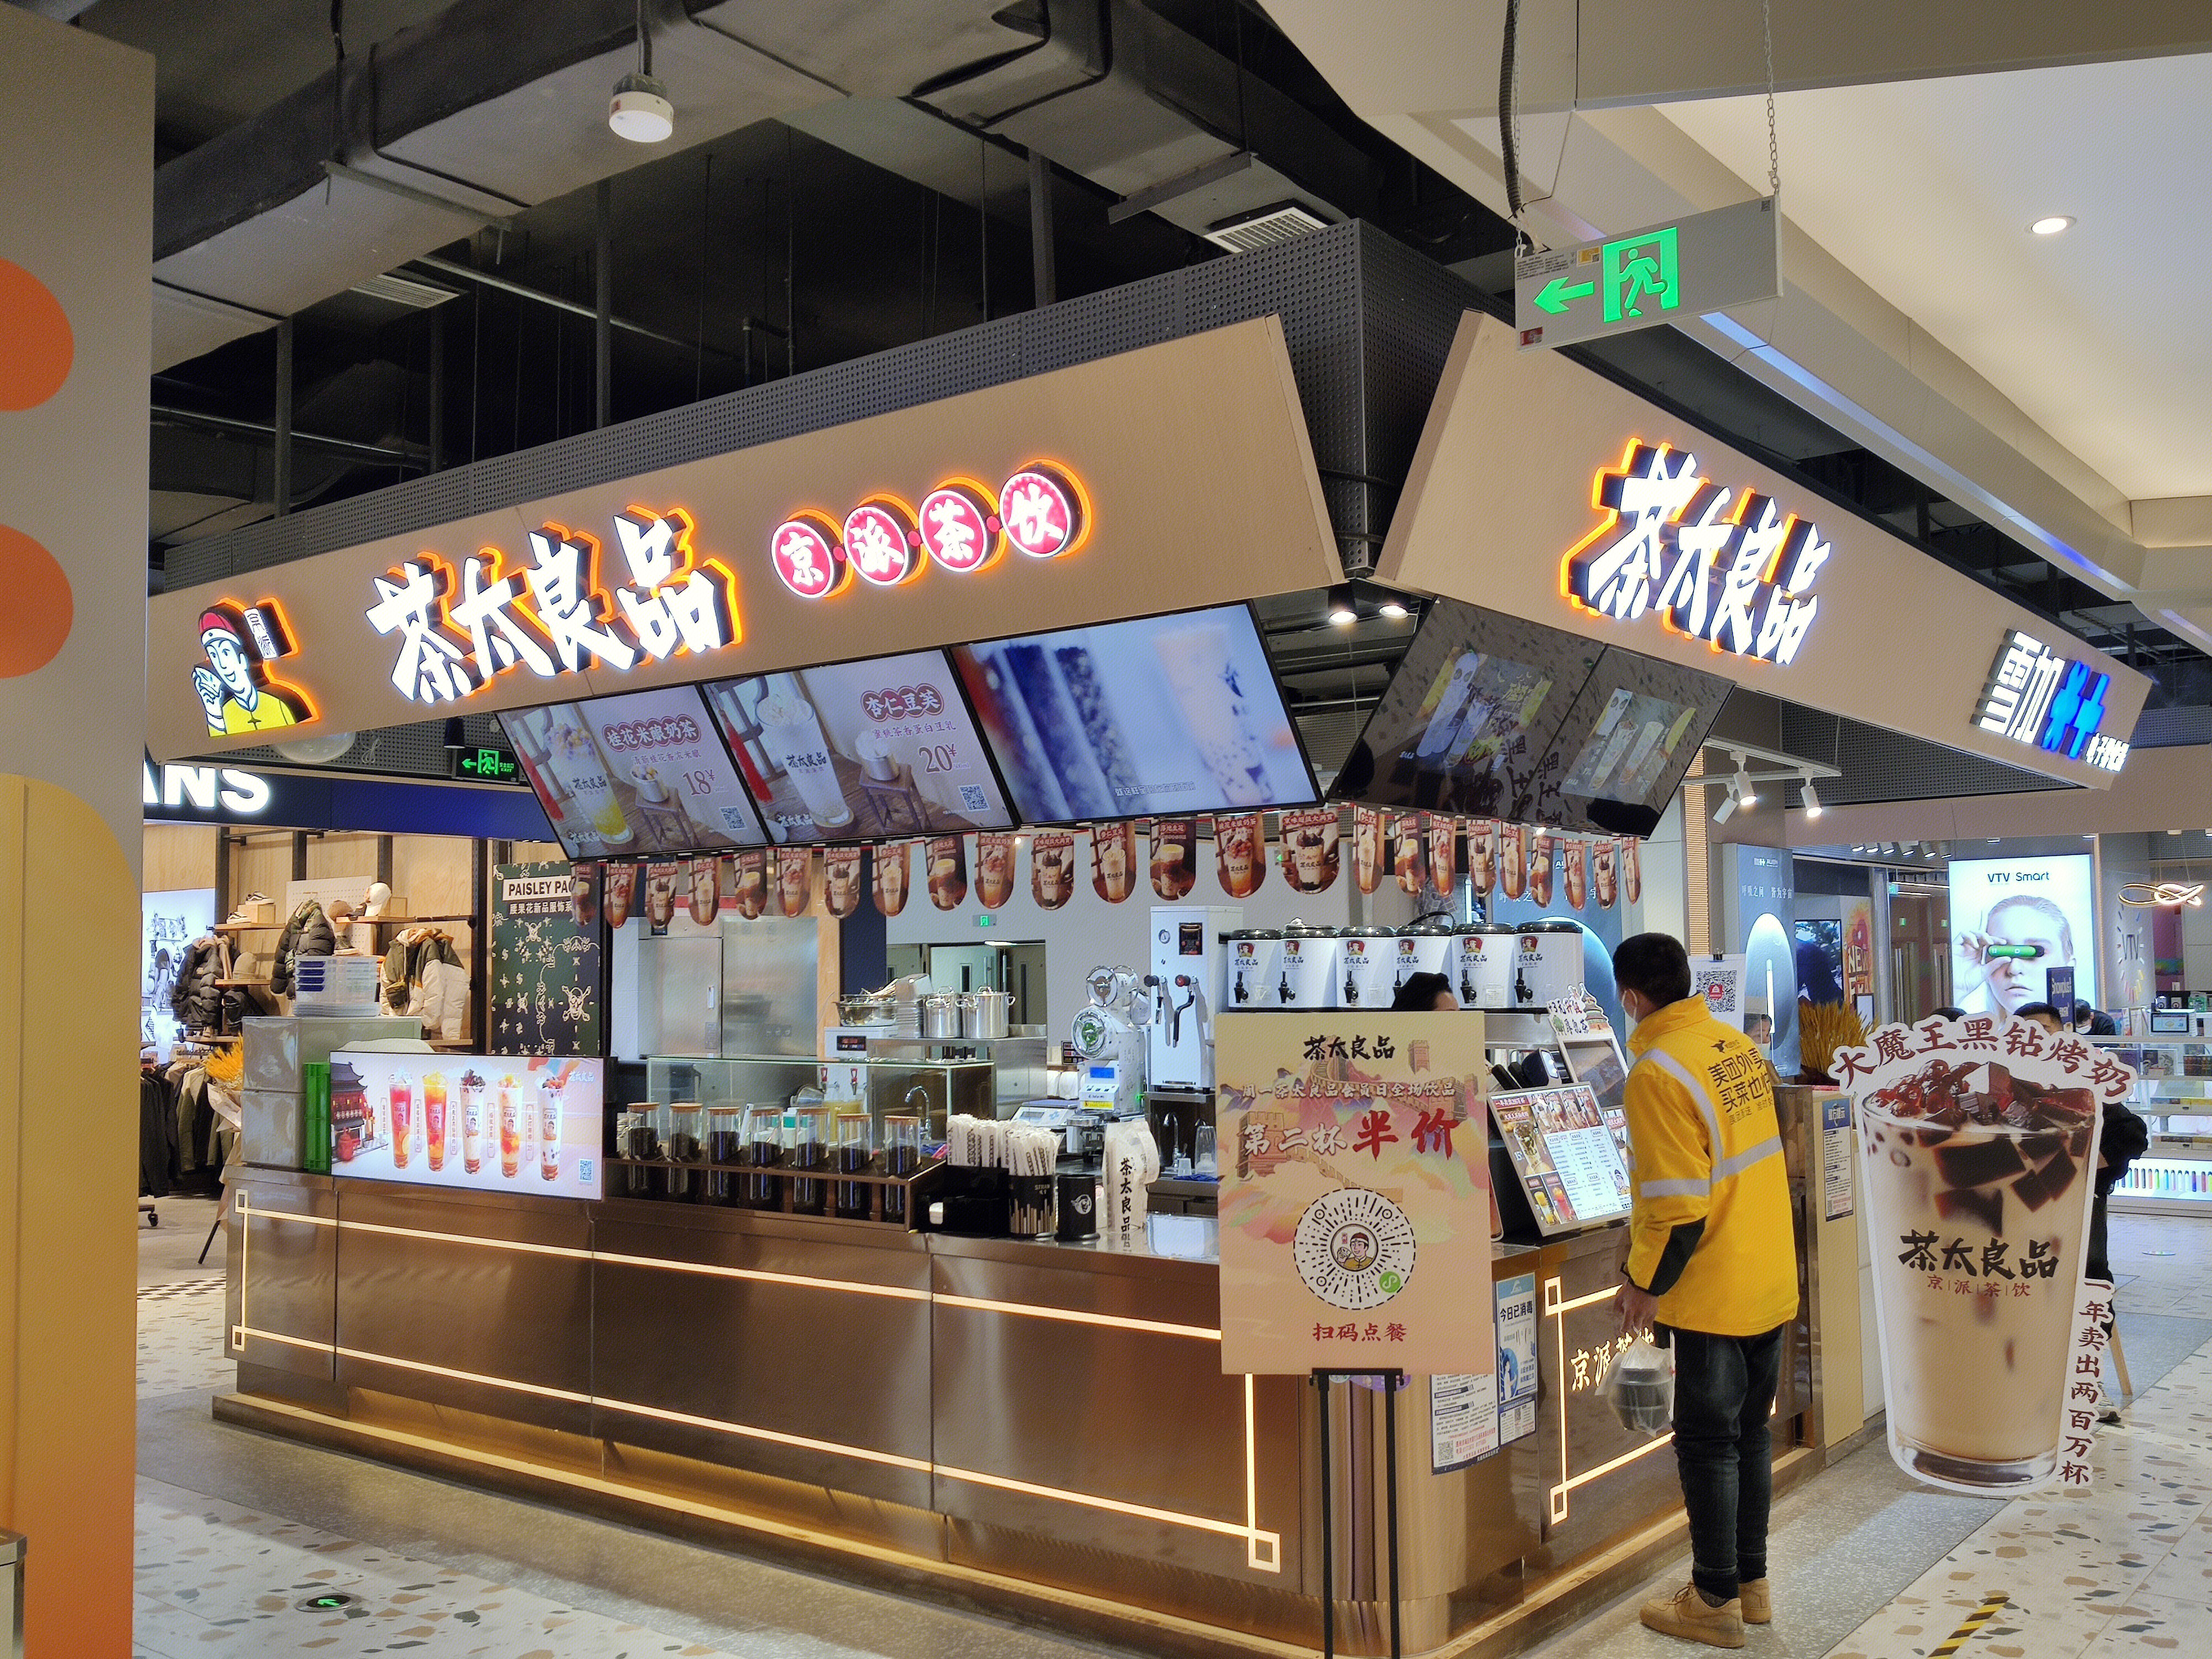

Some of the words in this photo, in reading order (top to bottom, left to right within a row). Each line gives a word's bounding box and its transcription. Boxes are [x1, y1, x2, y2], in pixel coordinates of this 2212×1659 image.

[780, 481, 1065, 587] 京派茶饮
[1588, 448, 1831, 665] 茶太良品
[364, 513, 724, 704] 茶太良品
[509, 881, 552, 896] PAISLEY
[1987, 873, 2010, 883] VTV
[2016, 872, 2049, 881] Smart
[509, 900, 573, 915] 腰果花新品服饰系
[1303, 1034, 1396, 1061] 茶太良品
[1707, 1047, 1765, 1088] 美团外卖
[1834, 1018, 2131, 1098] 大魔王黑钻烤奶
[1242, 1082, 1457, 1099] 周一茶太良品会员日全场饮品
[1120, 1157, 1133, 1233] 茶太良品
[1898, 1228, 2059, 1280] 茶太良品
[1500, 1300, 1533, 1322] 今日已消毒
[1312, 1322, 1407, 1342] 扫码点餐
[2058, 1280, 2112, 1485] 一年卖出两百万杯
